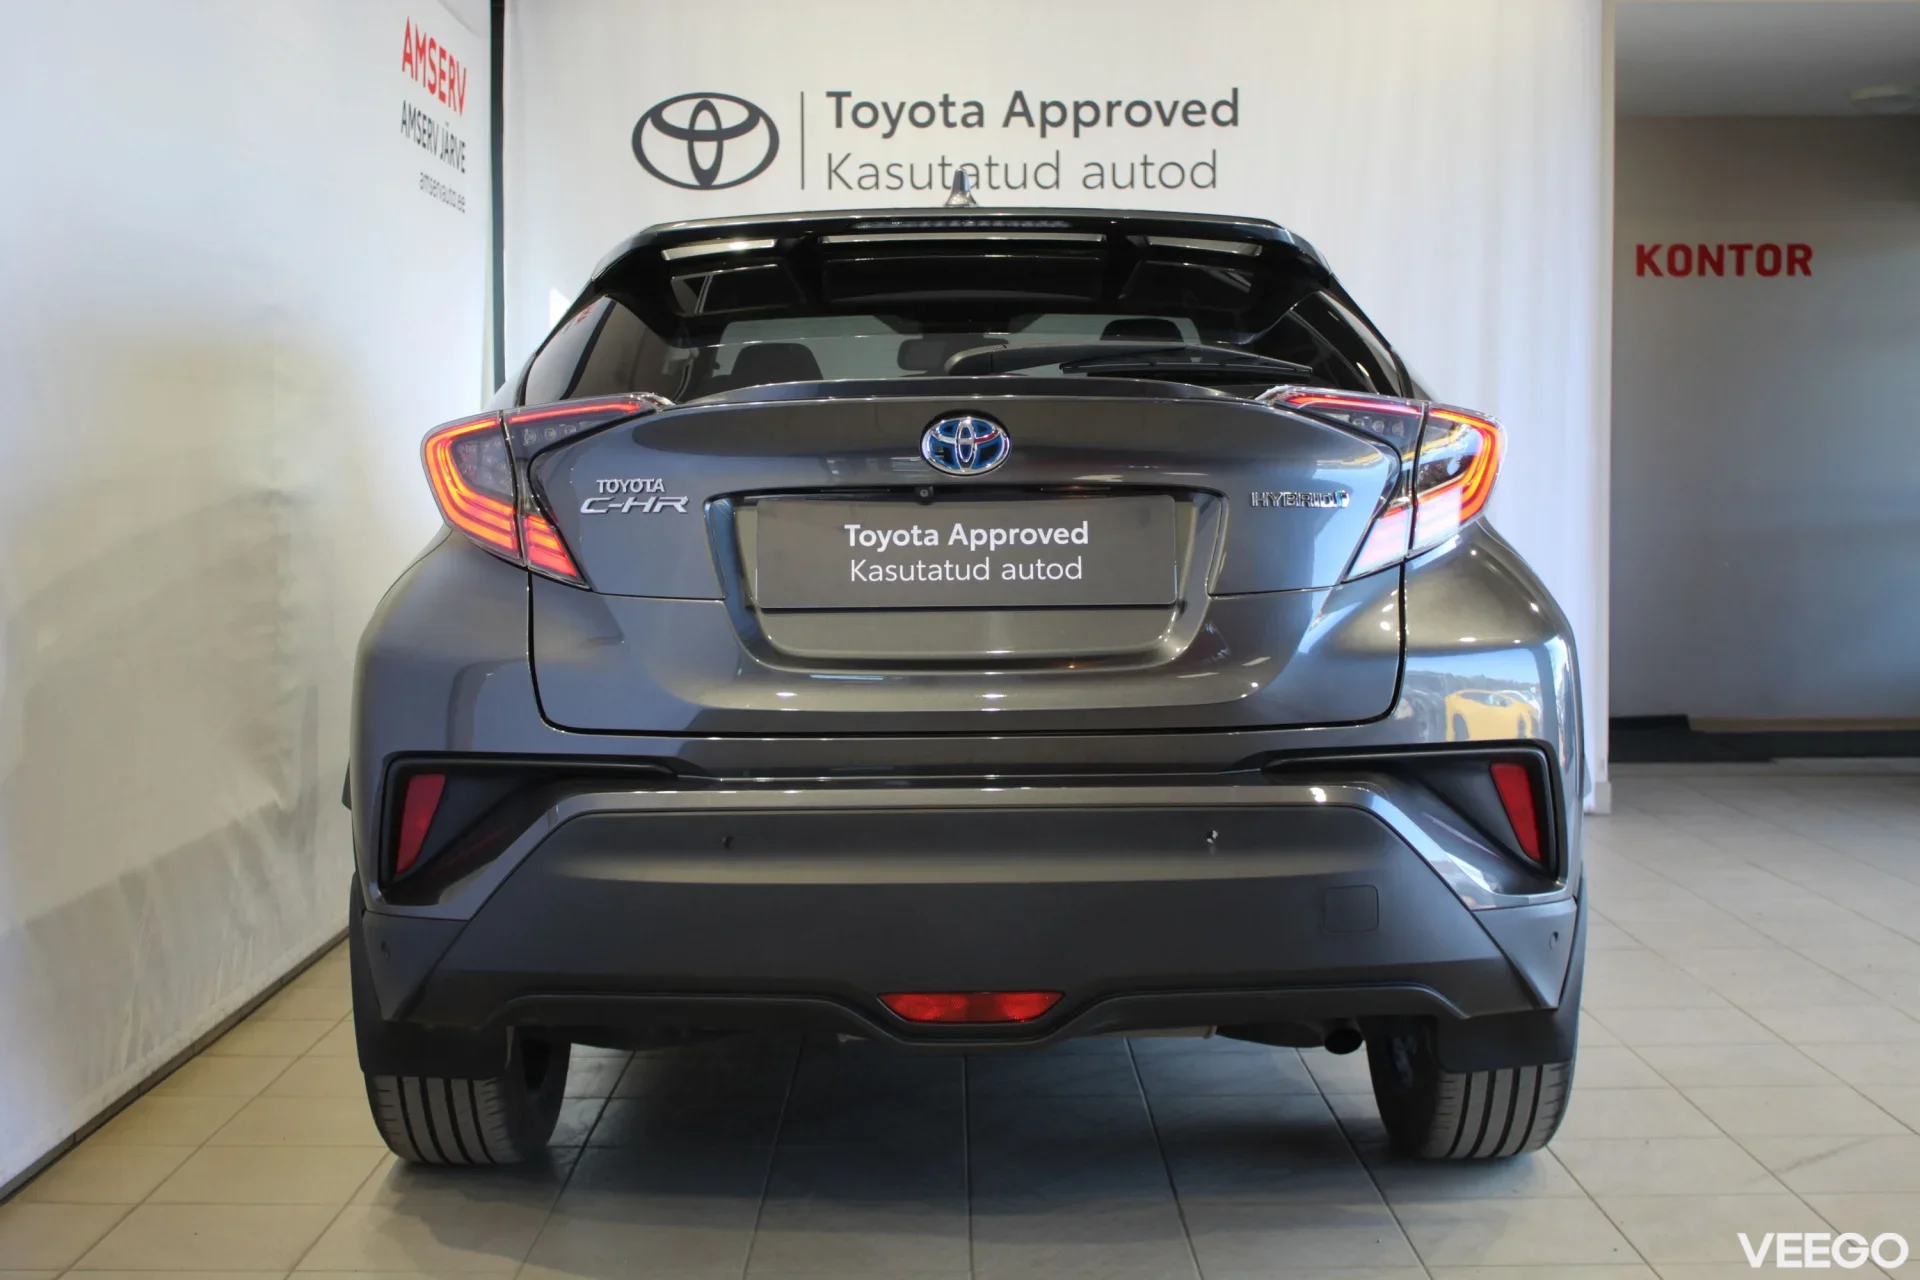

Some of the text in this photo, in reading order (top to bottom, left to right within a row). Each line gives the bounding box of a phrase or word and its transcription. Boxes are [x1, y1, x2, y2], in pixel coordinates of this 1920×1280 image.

[402, 16, 467, 117] AMSERV
[826, 88, 1240, 138] Toyota Approved
[401, 100, 466, 174] AMSERV JÄRVE
[827, 150, 1218, 190] Kasutatud autod
[1635, 243, 1813, 278] KONTOR
[596, 478, 665, 493] TOYOTA
[1251, 491, 1337, 508] HYBRID
[580, 496, 689, 514] C-HR
[844, 521, 1089, 553] Toyota Approved
[850, 556, 1083, 582] Kasutatud autod
